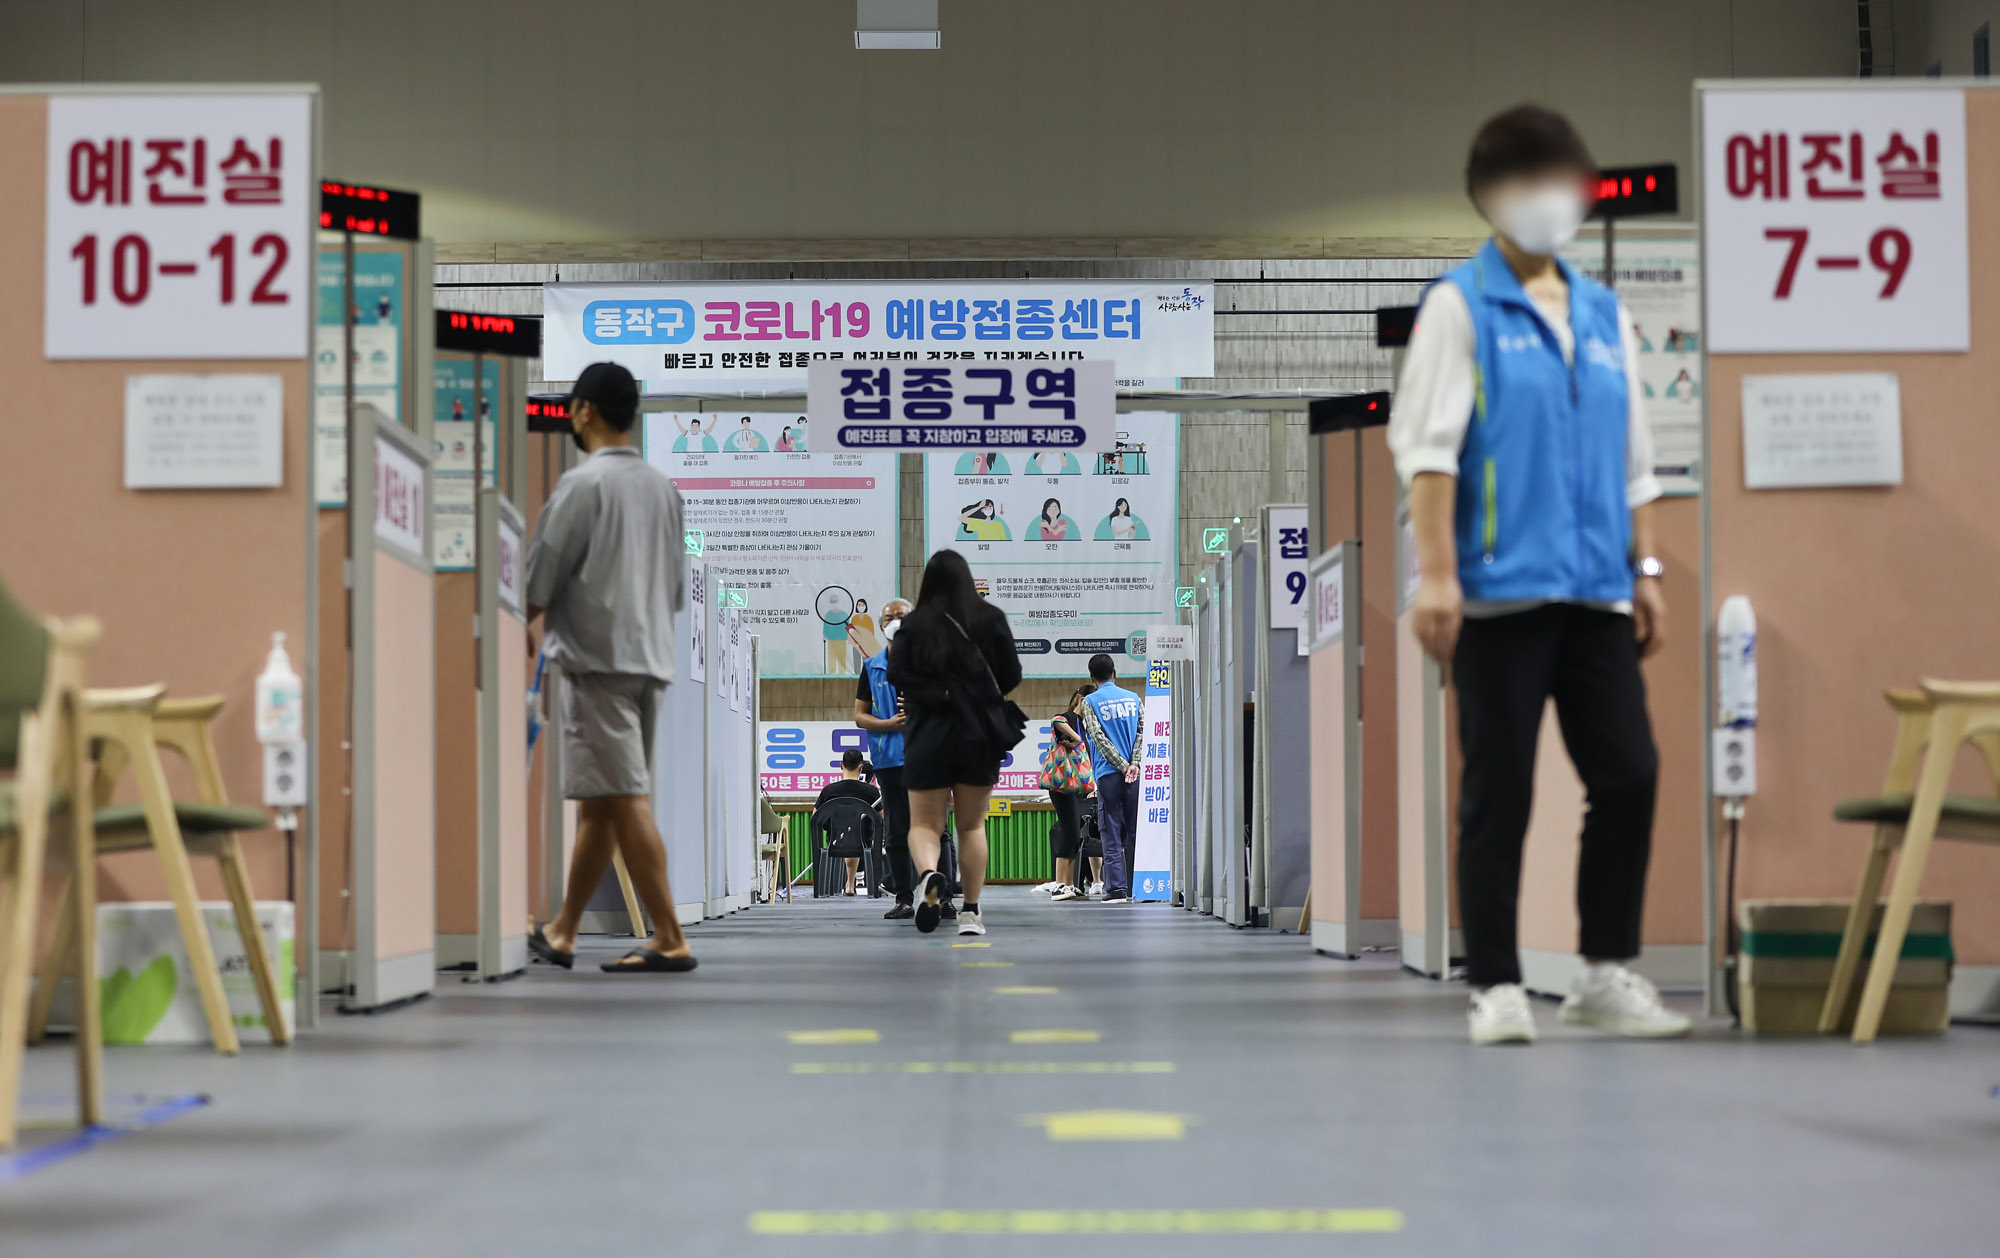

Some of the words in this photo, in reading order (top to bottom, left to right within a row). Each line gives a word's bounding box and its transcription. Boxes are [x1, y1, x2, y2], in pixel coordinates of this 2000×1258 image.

[69, 139, 283, 205] 예진실
[1725, 131, 1941, 199] 예진실
[71, 234, 290, 305] 10-12
[1764, 227, 1912, 299] 7-9
[594, 307, 685, 337] 동작구
[703, 300, 870, 341] 코로나19
[886, 299, 1141, 341] 예방접종센터
[1158, 302, 1191, 312] 사람사는
[664, 353, 713, 369] 빠르고
[721, 352, 771, 369] 안전한
[841, 368, 1076, 420] 접종구역
[845, 429, 903, 444] 예진표를
[906, 429, 921, 444] 꼭
[924, 429, 982, 444] 지참하고
[985, 429, 1029, 444] 입장해
[1032, 429, 1079, 444] 주세요.
[1286, 571, 1307, 605] 9
[1100, 702, 1137, 721] STAFF
[761, 776, 791, 789] 30분
[797, 776, 825, 789] 동안
